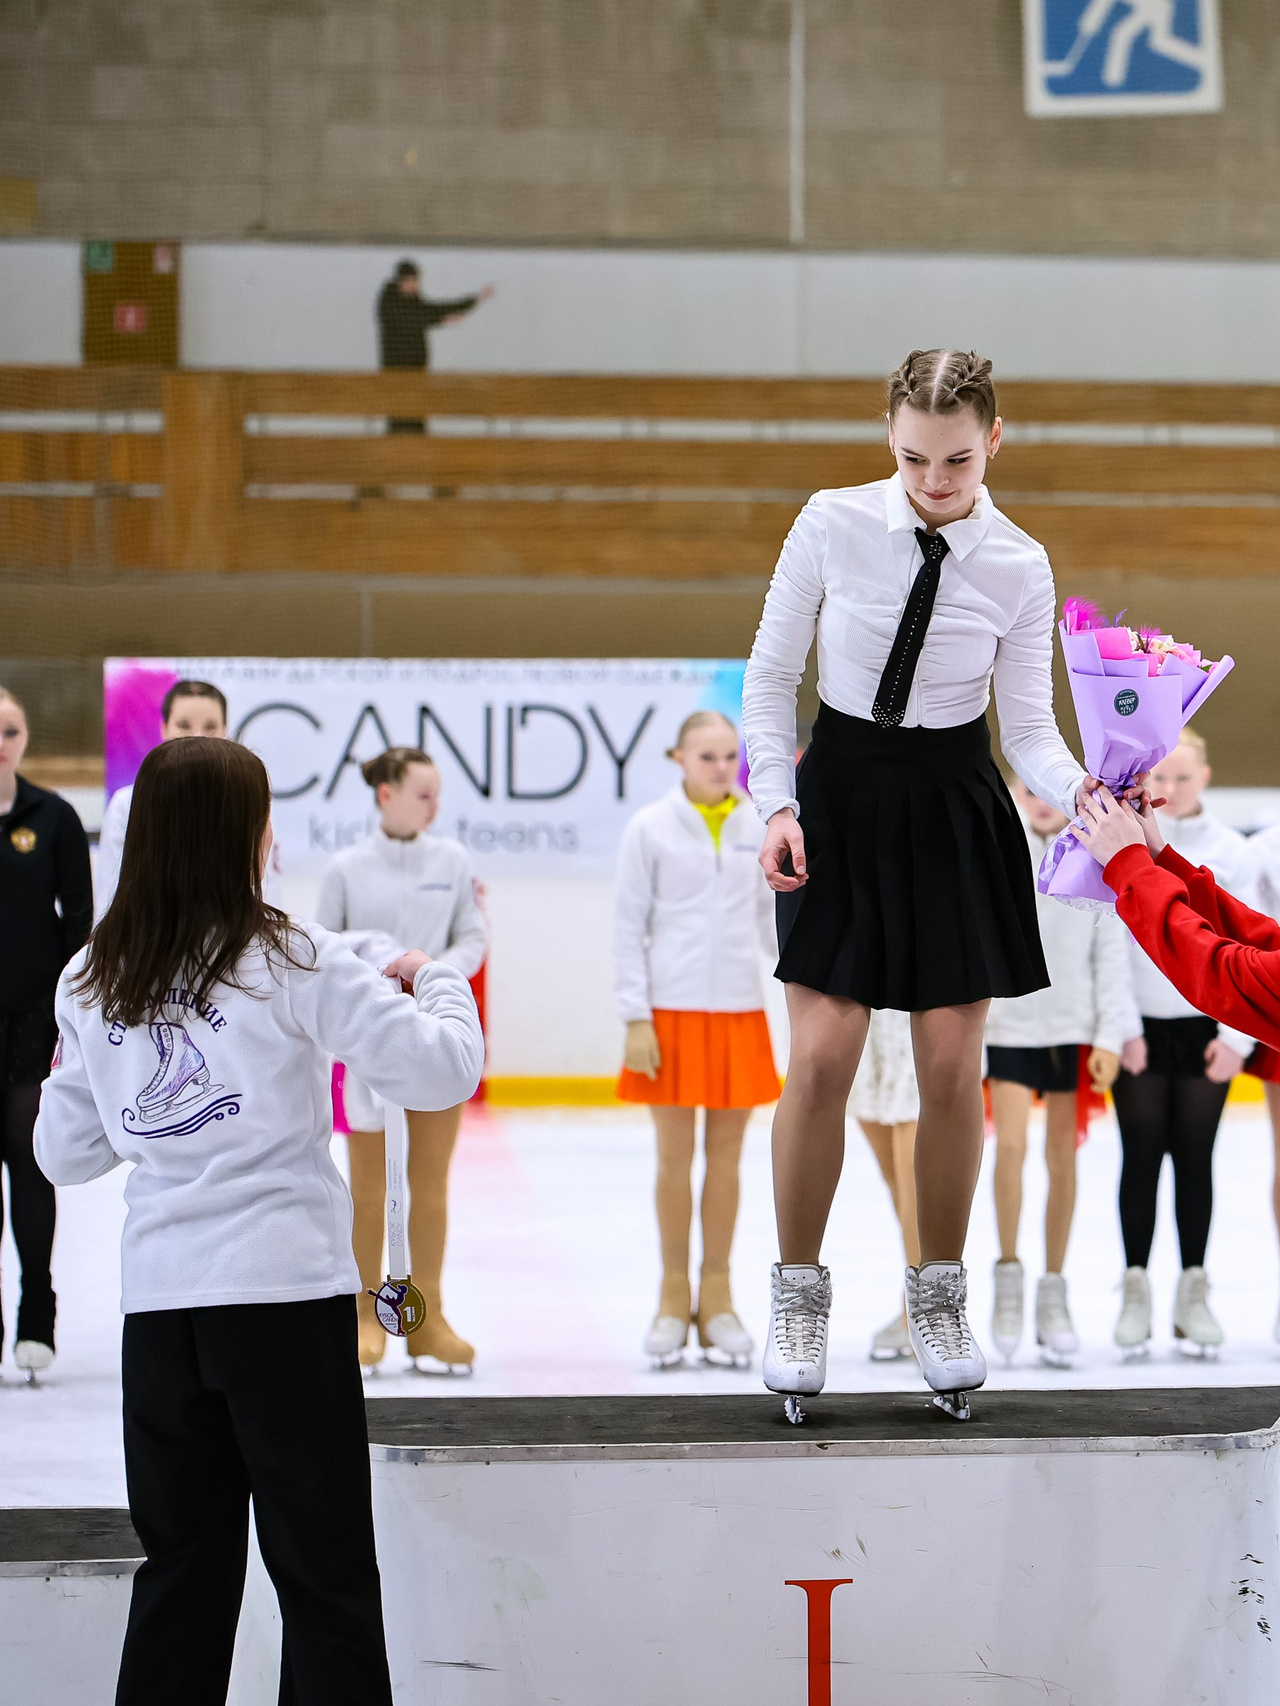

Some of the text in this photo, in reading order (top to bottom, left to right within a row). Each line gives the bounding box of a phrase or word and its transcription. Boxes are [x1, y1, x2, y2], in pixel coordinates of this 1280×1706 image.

[233, 702, 656, 800] CANDY
[307, 812, 380, 851] kid
[108, 988, 227, 1046] СТЛЕИЕ
